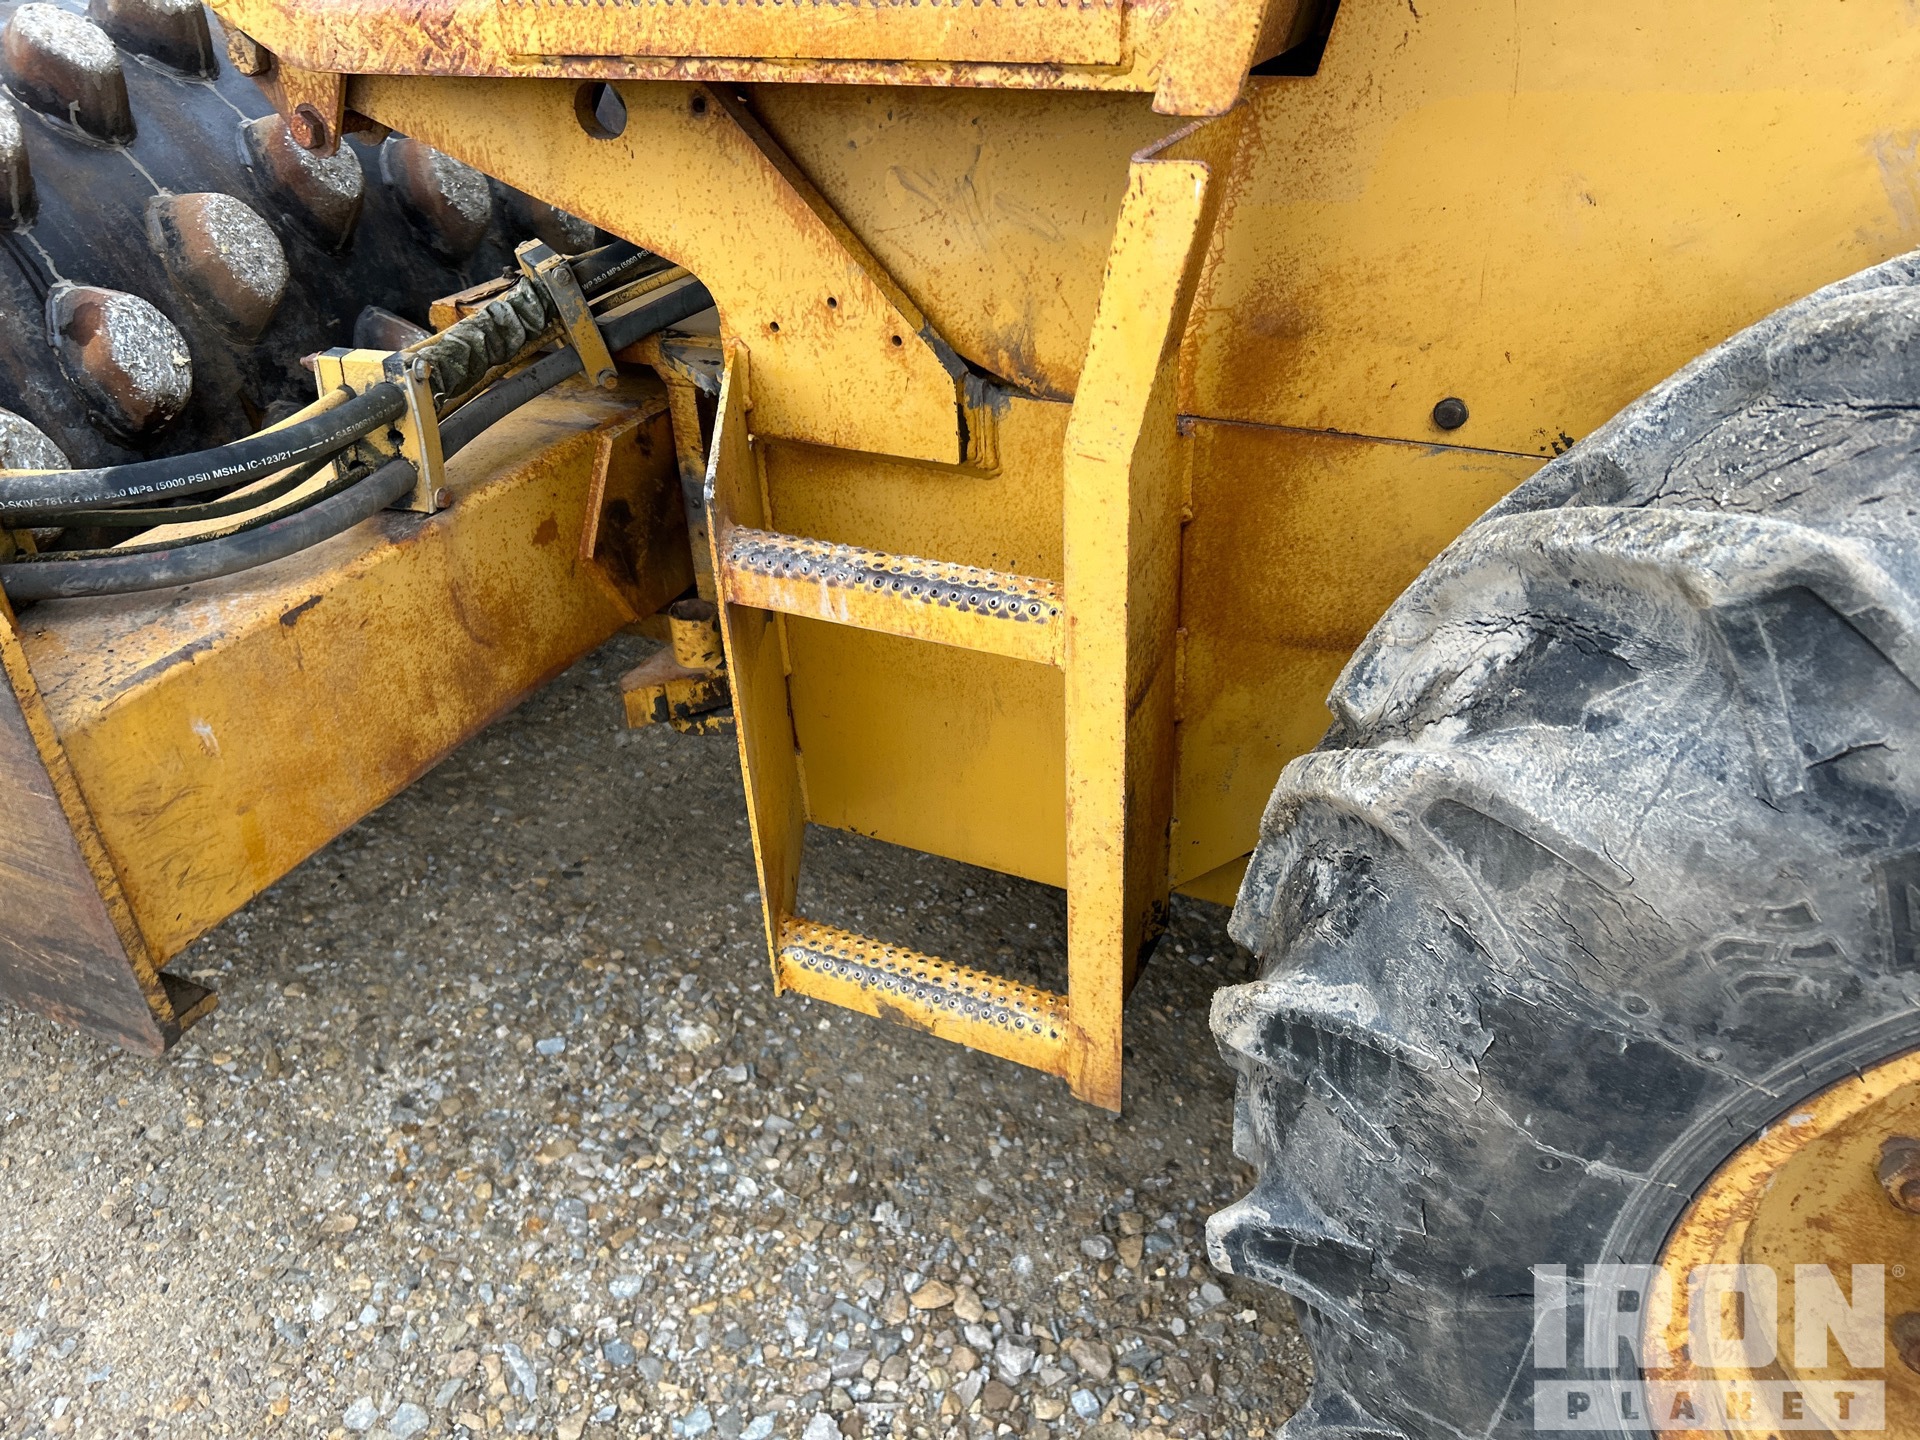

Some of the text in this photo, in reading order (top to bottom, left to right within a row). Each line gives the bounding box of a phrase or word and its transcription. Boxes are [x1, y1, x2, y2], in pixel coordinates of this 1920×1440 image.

[581, 280, 593, 291] WP
[606, 266, 622, 278] MPa
[620, 255, 639, 269] (5000
[636, 248, 652, 260] PSI
[129, 484, 154, 497] MPa
[155, 478, 186, 491] (5000
[187, 472, 211, 485] PSI)
[212, 463, 246, 479] MSHA
[246, 450, 292, 470] IC-123/21
